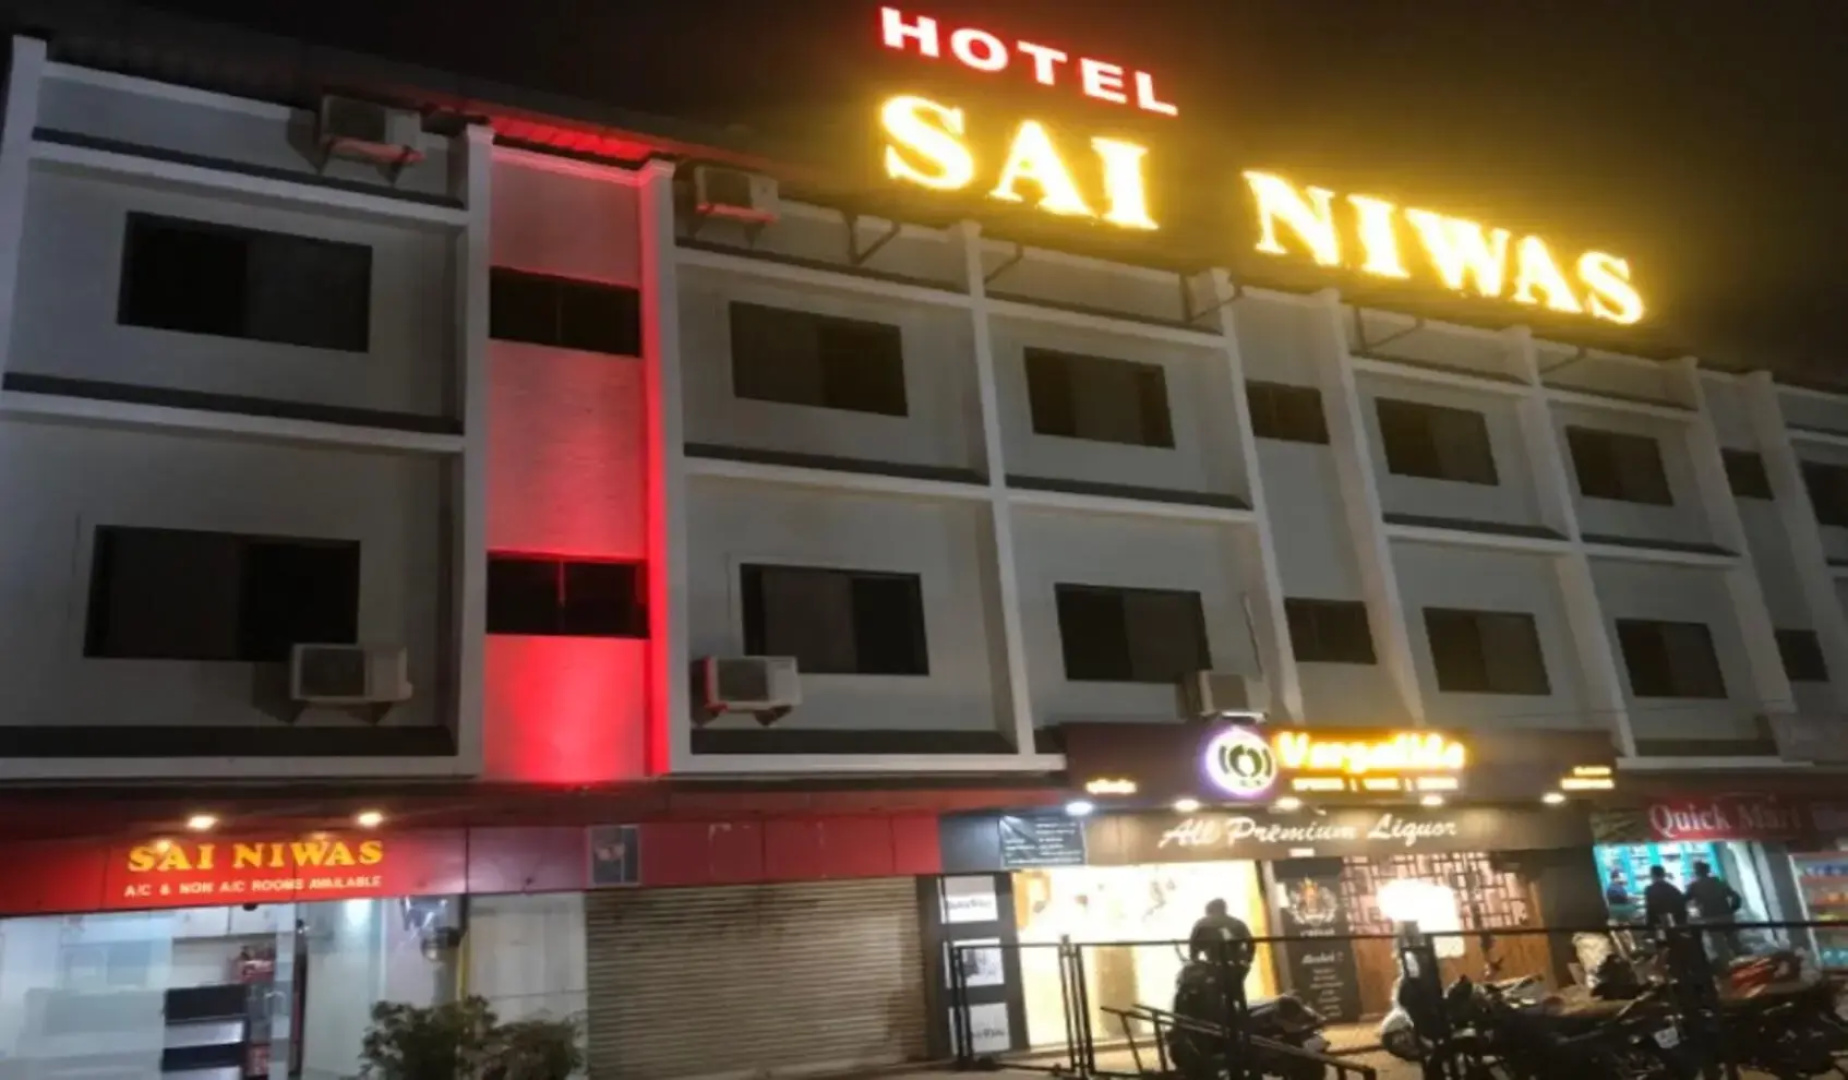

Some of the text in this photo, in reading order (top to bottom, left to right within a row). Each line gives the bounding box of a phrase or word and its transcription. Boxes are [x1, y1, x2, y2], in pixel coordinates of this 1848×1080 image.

[880, 7, 1179, 117] HOTEL
[880, 94, 1646, 325] SAI NIWAS
[1158, 813, 1458, 848] All Premium Liquor
[1649, 803, 1731, 839] Quick
[128, 840, 383, 871] SAI NIWAS
[179, 882, 213, 895] NON
[252, 877, 303, 891] ROOMS
[308, 875, 382, 890] AVAILABLE
